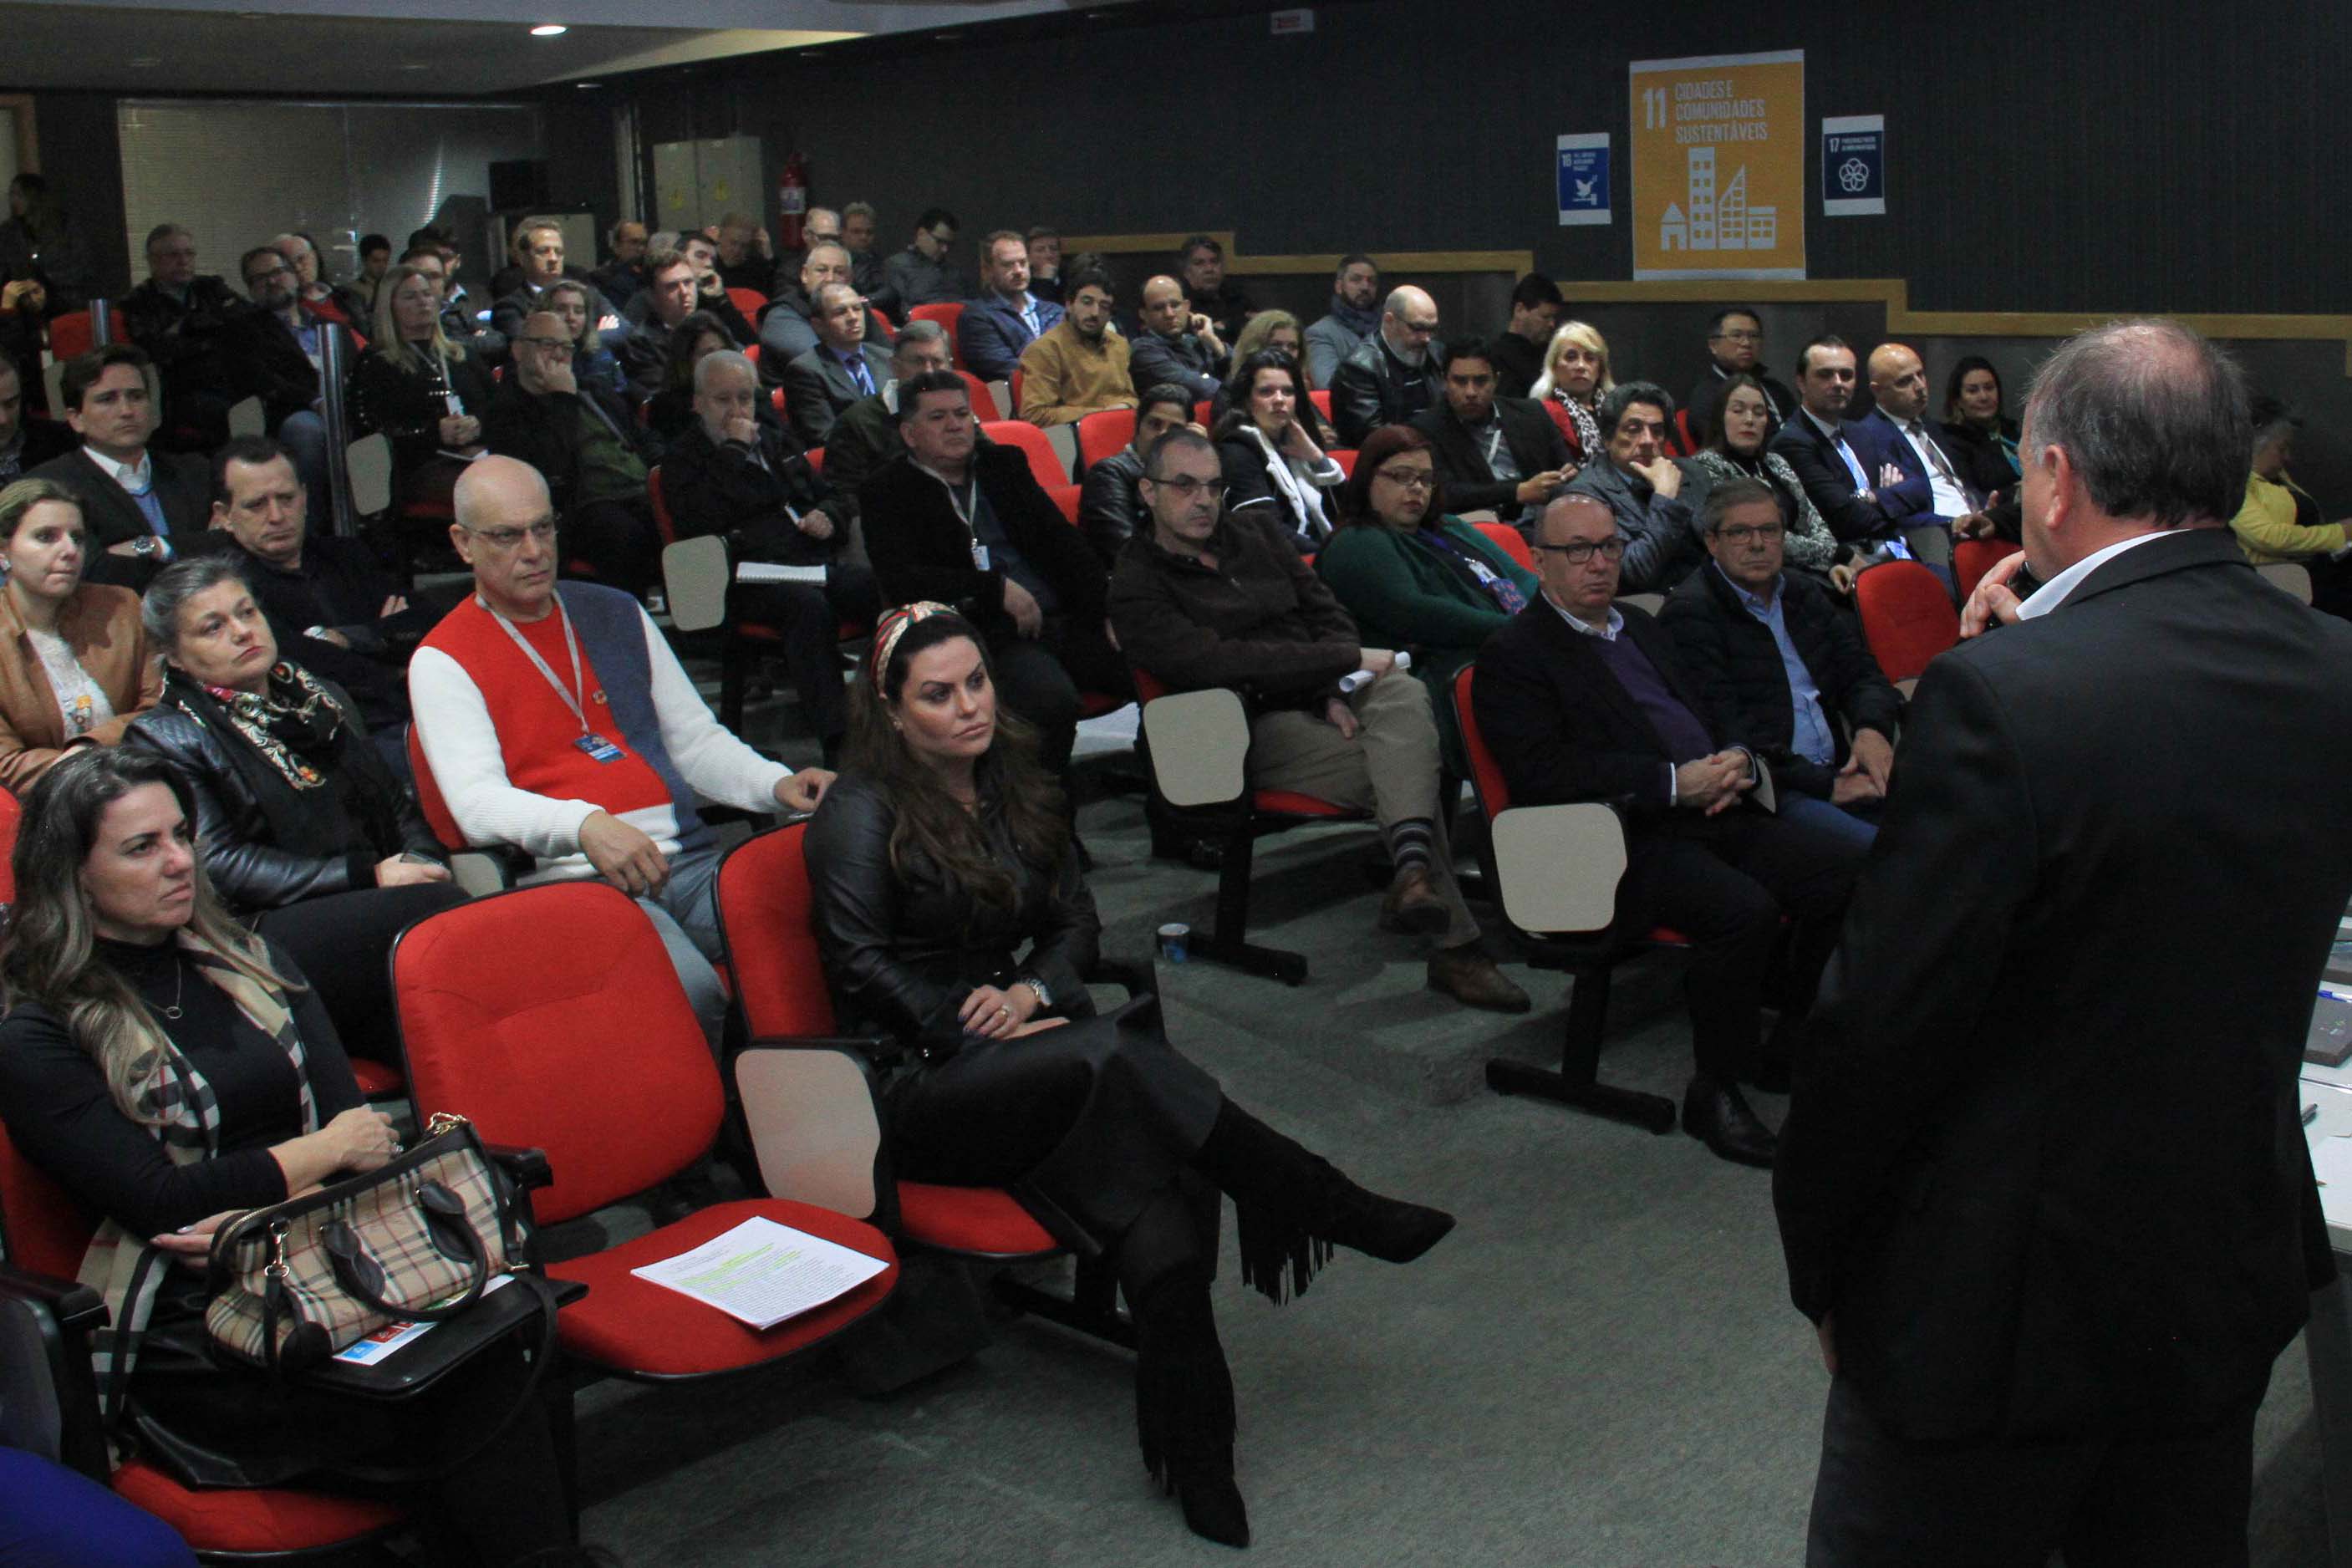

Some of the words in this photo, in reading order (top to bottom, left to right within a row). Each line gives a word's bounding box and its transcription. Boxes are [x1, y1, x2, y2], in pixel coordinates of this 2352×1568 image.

[1676, 80, 1725, 99] CIDADES
[1726, 79, 1733, 97] E
[1644, 87, 1667, 130] 11
[1676, 99, 1765, 120] COMUNIDADES
